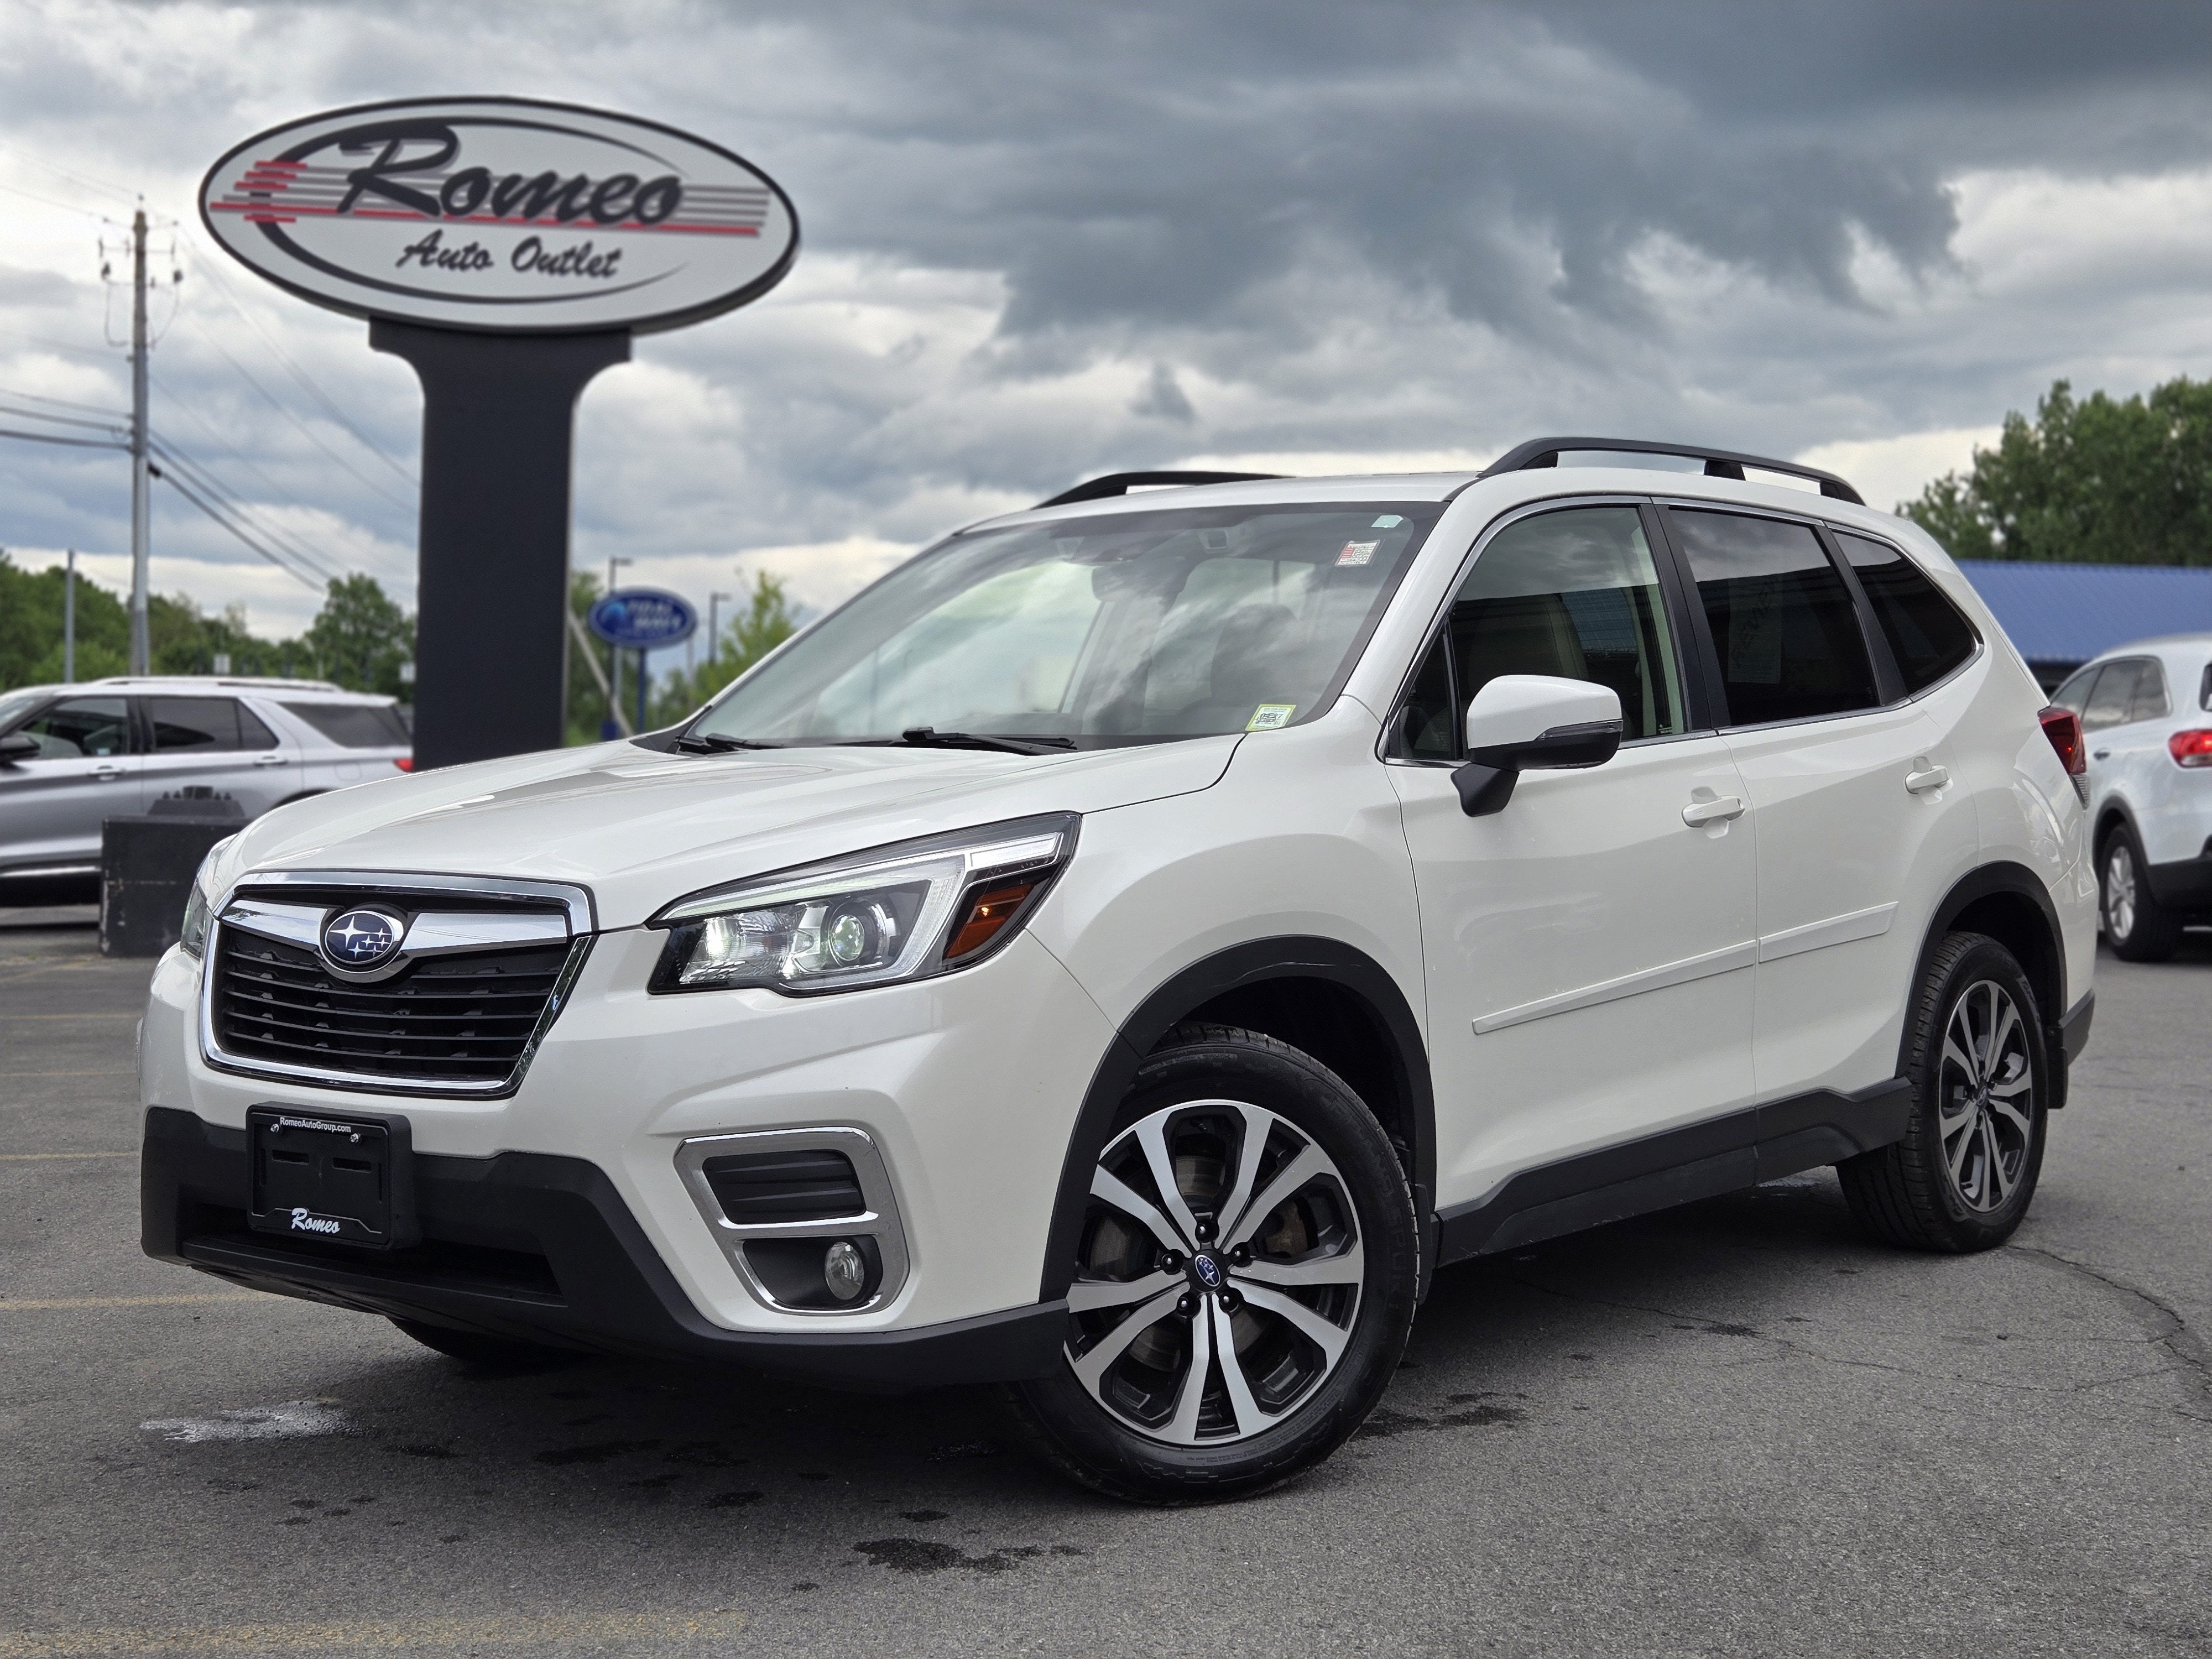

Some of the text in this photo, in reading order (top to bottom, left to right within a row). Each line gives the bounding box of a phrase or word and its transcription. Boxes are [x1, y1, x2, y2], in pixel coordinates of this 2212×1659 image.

[336, 124, 682, 223] Romeo
[395, 229, 622, 277] Auto Outlet
[280, 1117, 351, 1133] RomeoAutoGroup.com
[291, 1208, 340, 1234] Romeo
